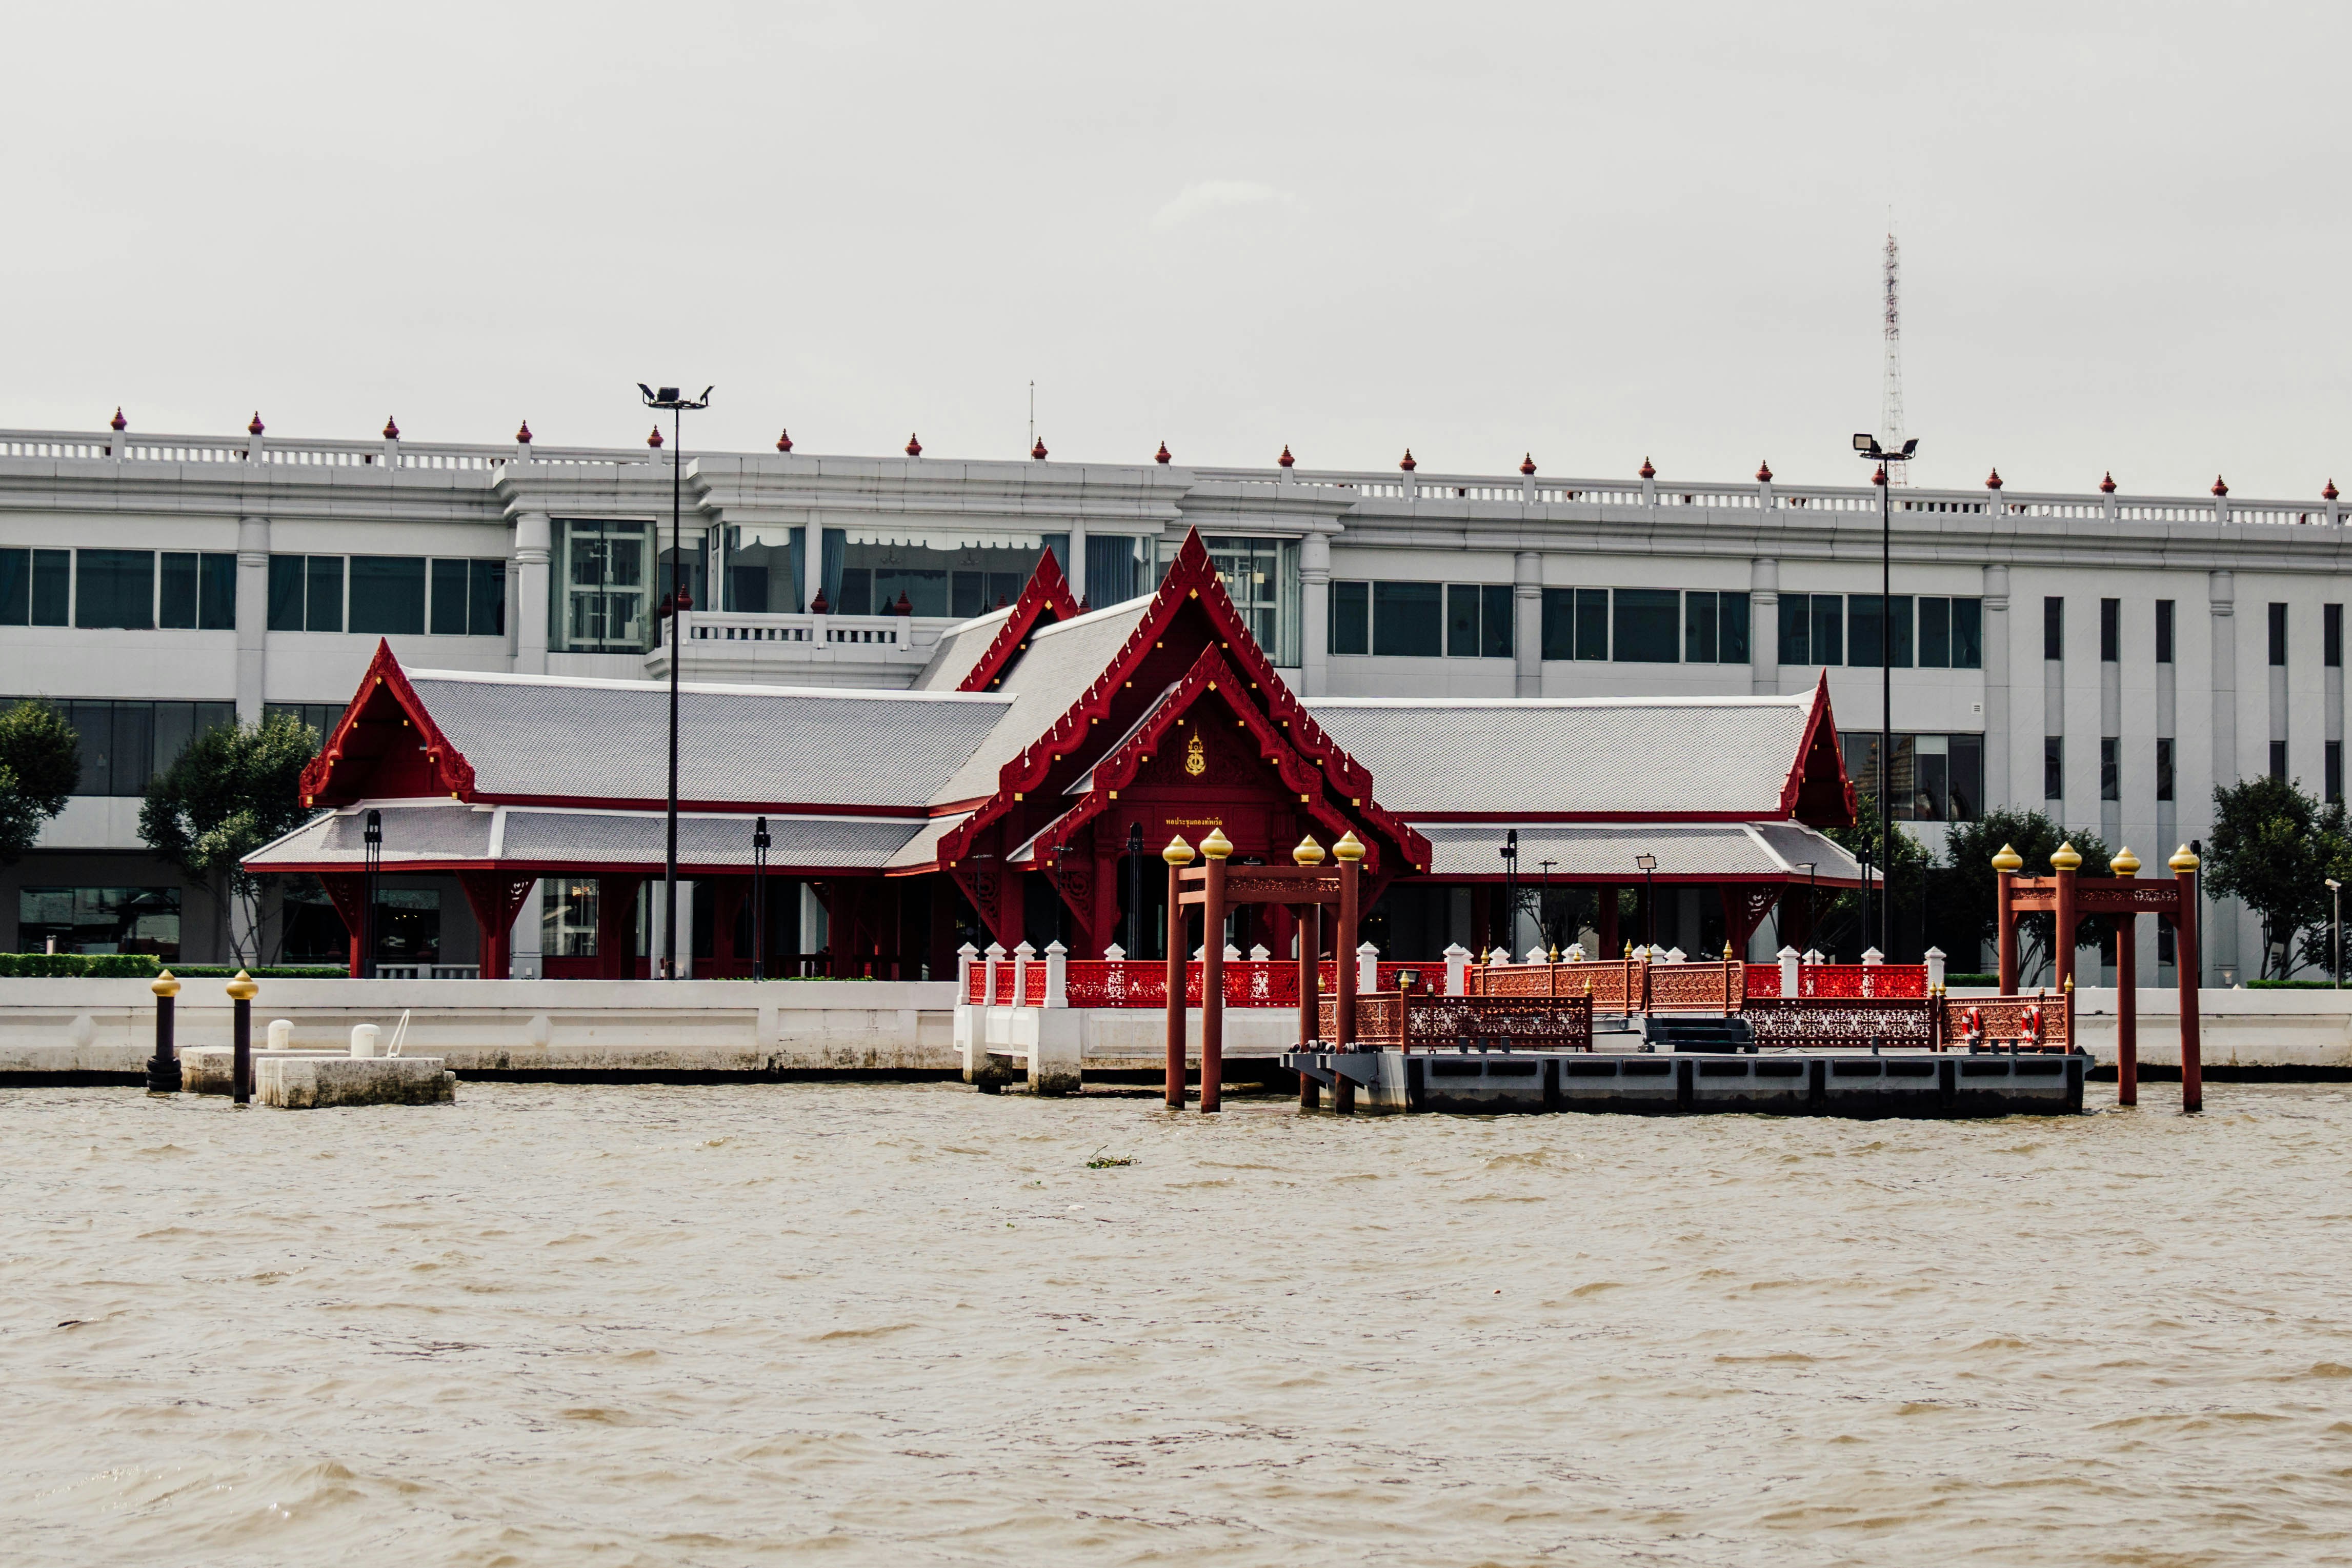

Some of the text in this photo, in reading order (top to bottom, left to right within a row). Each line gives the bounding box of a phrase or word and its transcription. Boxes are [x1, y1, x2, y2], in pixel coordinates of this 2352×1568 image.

[1165, 817, 1222, 828] หอประชุมกองทัพเรือ
